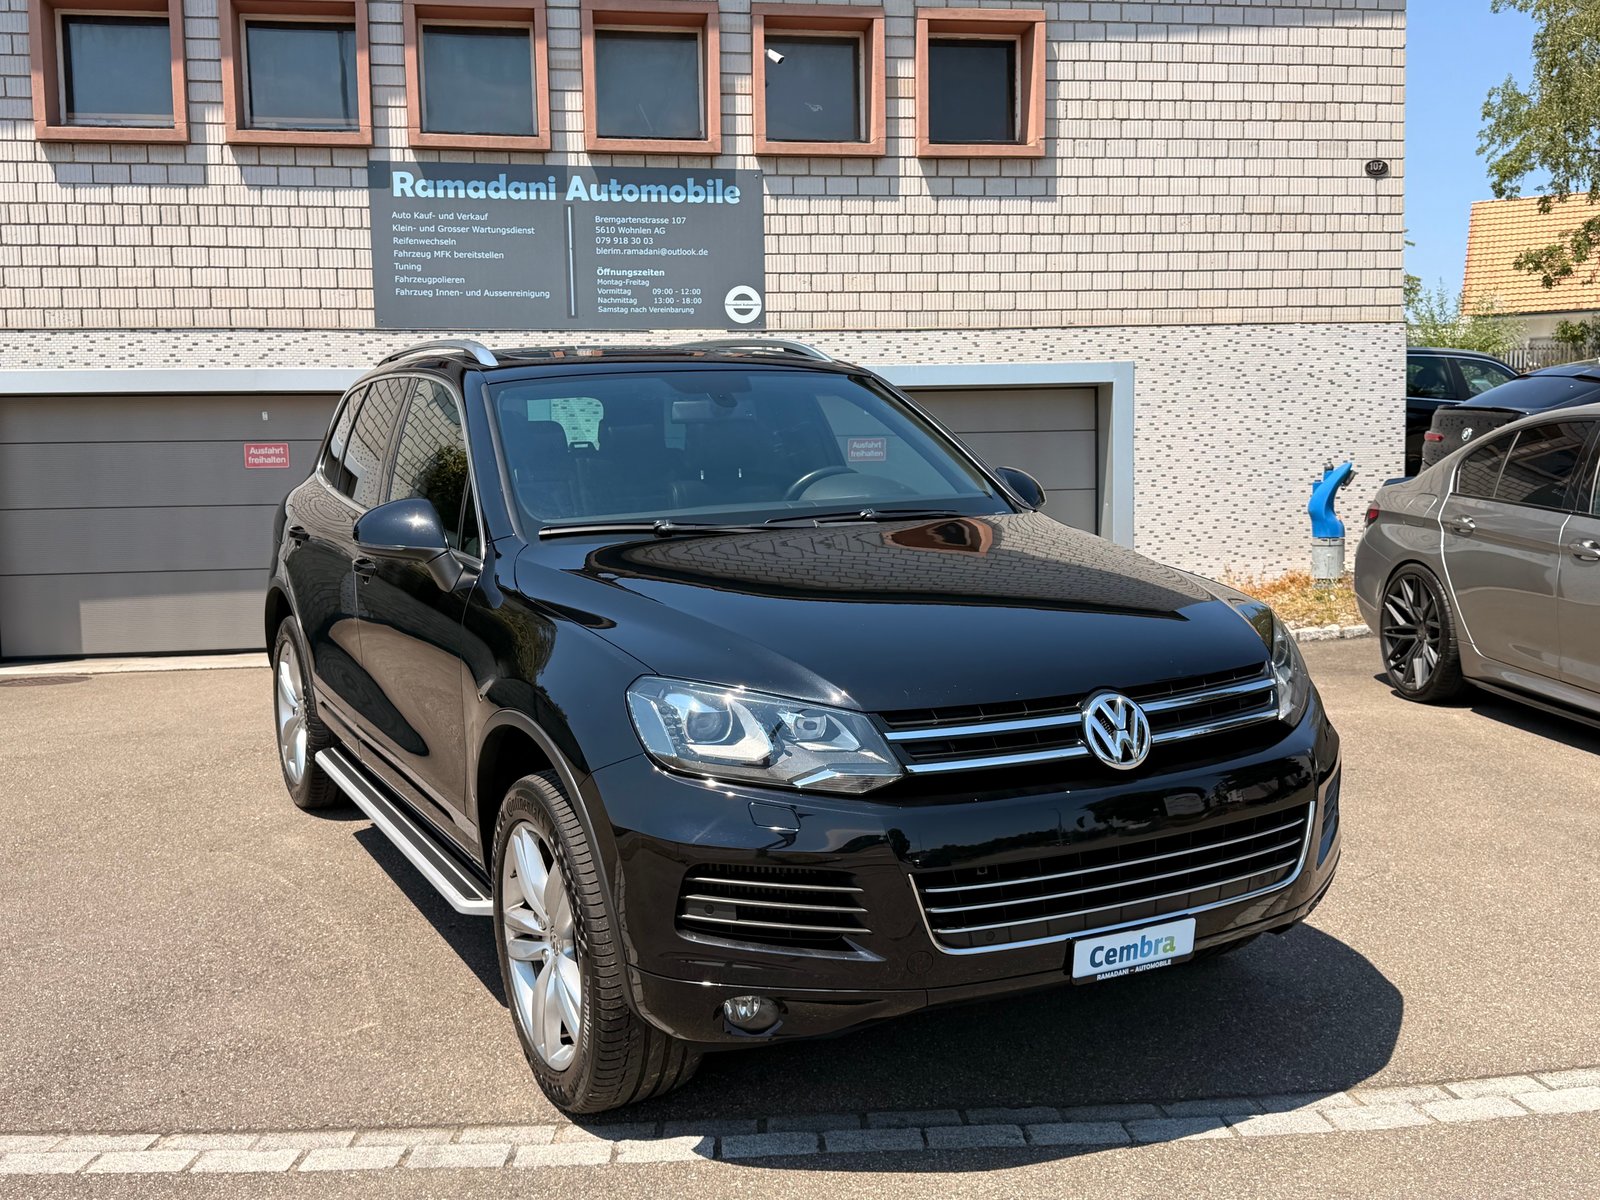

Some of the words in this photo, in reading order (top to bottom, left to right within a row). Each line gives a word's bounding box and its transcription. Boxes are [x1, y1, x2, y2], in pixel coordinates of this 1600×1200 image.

[1369, 161, 1383, 171] 107
[392, 171, 557, 201] Ramadani
[565, 175, 741, 205] Automobile
[391, 211, 412, 219] Auto
[413, 211, 436, 220] Kauf-
[456, 212, 489, 220] Verkauf
[595, 215, 670, 225] Bremgartenstrasse
[671, 217, 687, 225] 107
[392, 224, 417, 232] Klein-
[419, 225, 436, 233] und
[437, 225, 470, 233] Grosser
[471, 225, 536, 236] Wartungsdienst
[595, 226, 616, 234] 5610
[653, 227, 666, 235] AG
[393, 237, 457, 246] Reifenwechseln
[595, 237, 611, 245] 079
[613, 237, 629, 245] 918
[630, 237, 641, 245] 30
[393, 250, 431, 259] Fahrzeug
[433, 250, 452, 259] MFK
[453, 250, 505, 259] bereitstellen
[393, 263, 422, 272] Tuning
[596, 266, 666, 278] Öffnungszeiten
[394, 275, 465, 285] Fahrzeugpolieren
[597, 279, 650, 287] Montag-Freitag
[435, 288, 464, 297] Innen-
[465, 289, 482, 297] und
[483, 289, 551, 299] Aussenreinigung
[597, 288, 632, 296] Vormittag
[652, 288, 673, 296] 09:00
[680, 288, 702, 296] 12:00
[597, 297, 638, 305] Nachmittag
[654, 297, 675, 305] 13:00
[597, 306, 629, 314] Samstag
[648, 306, 695, 315] Vereinbarung
[249, 446, 284, 455] Ausfahrt
[248, 455, 287, 464] freihalten
[1089, 934, 1176, 969] Cembra
[1096, 968, 1130, 981] RAMADANI
[1134, 958, 1172, 973] AUTOMOBILE
